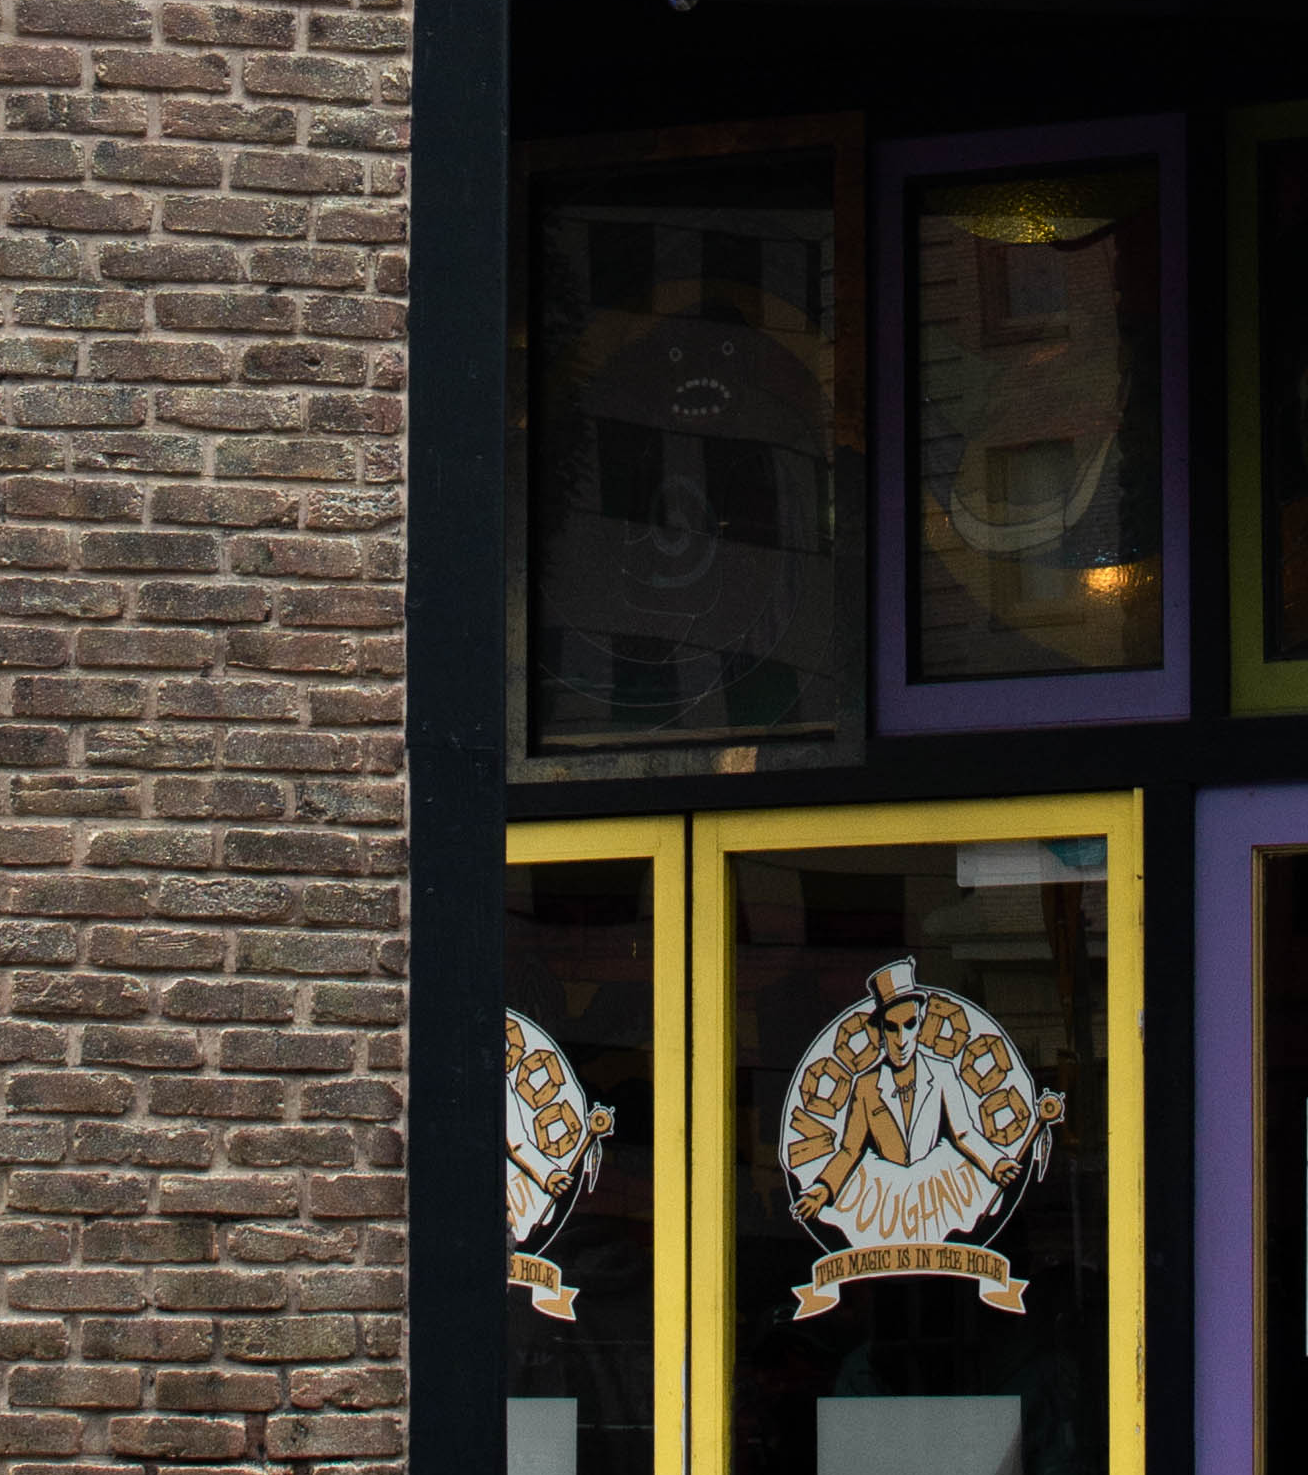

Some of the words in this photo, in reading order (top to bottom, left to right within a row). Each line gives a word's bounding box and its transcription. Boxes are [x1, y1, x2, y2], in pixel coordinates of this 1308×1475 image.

[788, 992, 1029, 1169] VOODOO
[834, 1158, 985, 1243] DOUGHNUT
[817, 1256, 844, 1285] THE
[848, 1249, 891, 1276] MAGIC
[896, 1247, 912, 1271] IS
[916, 1247, 934, 1269] IN
[935, 1247, 963, 1271] THE
[965, 1251, 1002, 1281] HOLE
